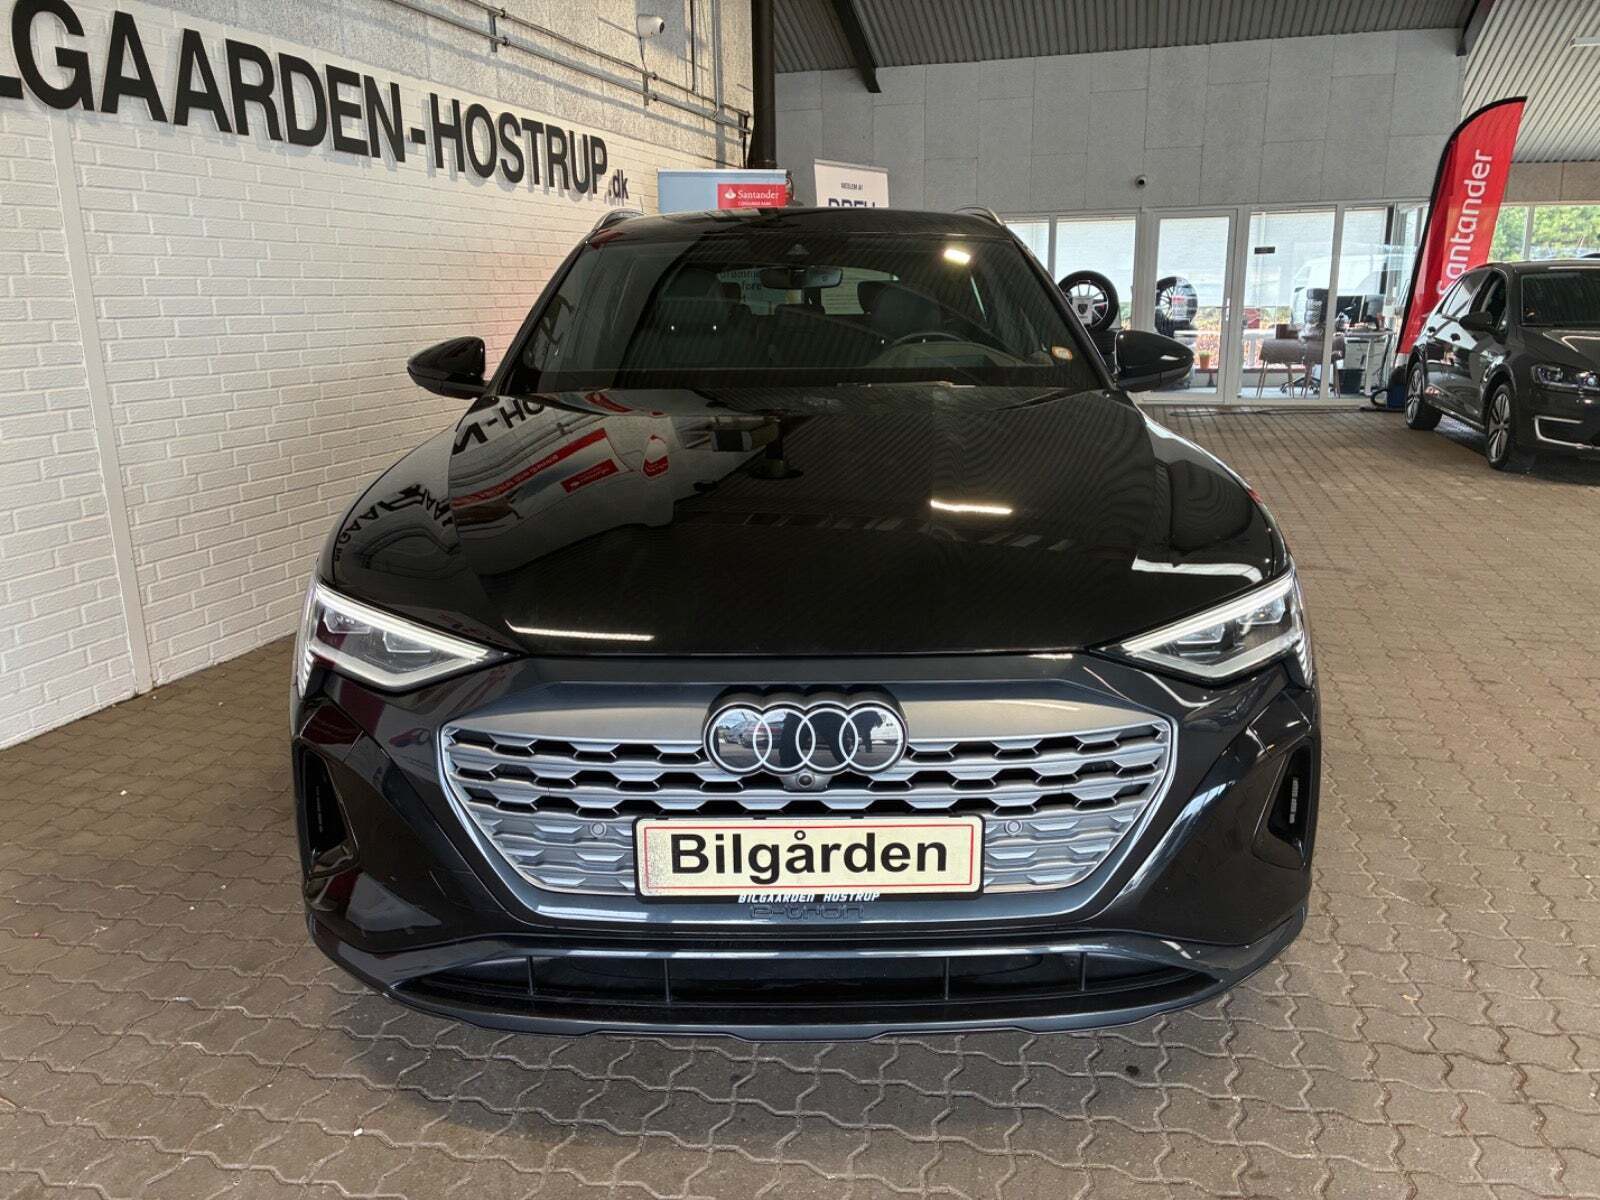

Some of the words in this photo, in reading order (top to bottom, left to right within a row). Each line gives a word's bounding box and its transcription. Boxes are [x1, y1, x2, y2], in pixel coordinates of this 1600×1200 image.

[737, 189, 779, 199] Santander
[671, 830, 947, 885] Bilgården
[738, 893, 815, 904] BILGAARDEN
[823, 892, 881, 903] HOSTRUP
